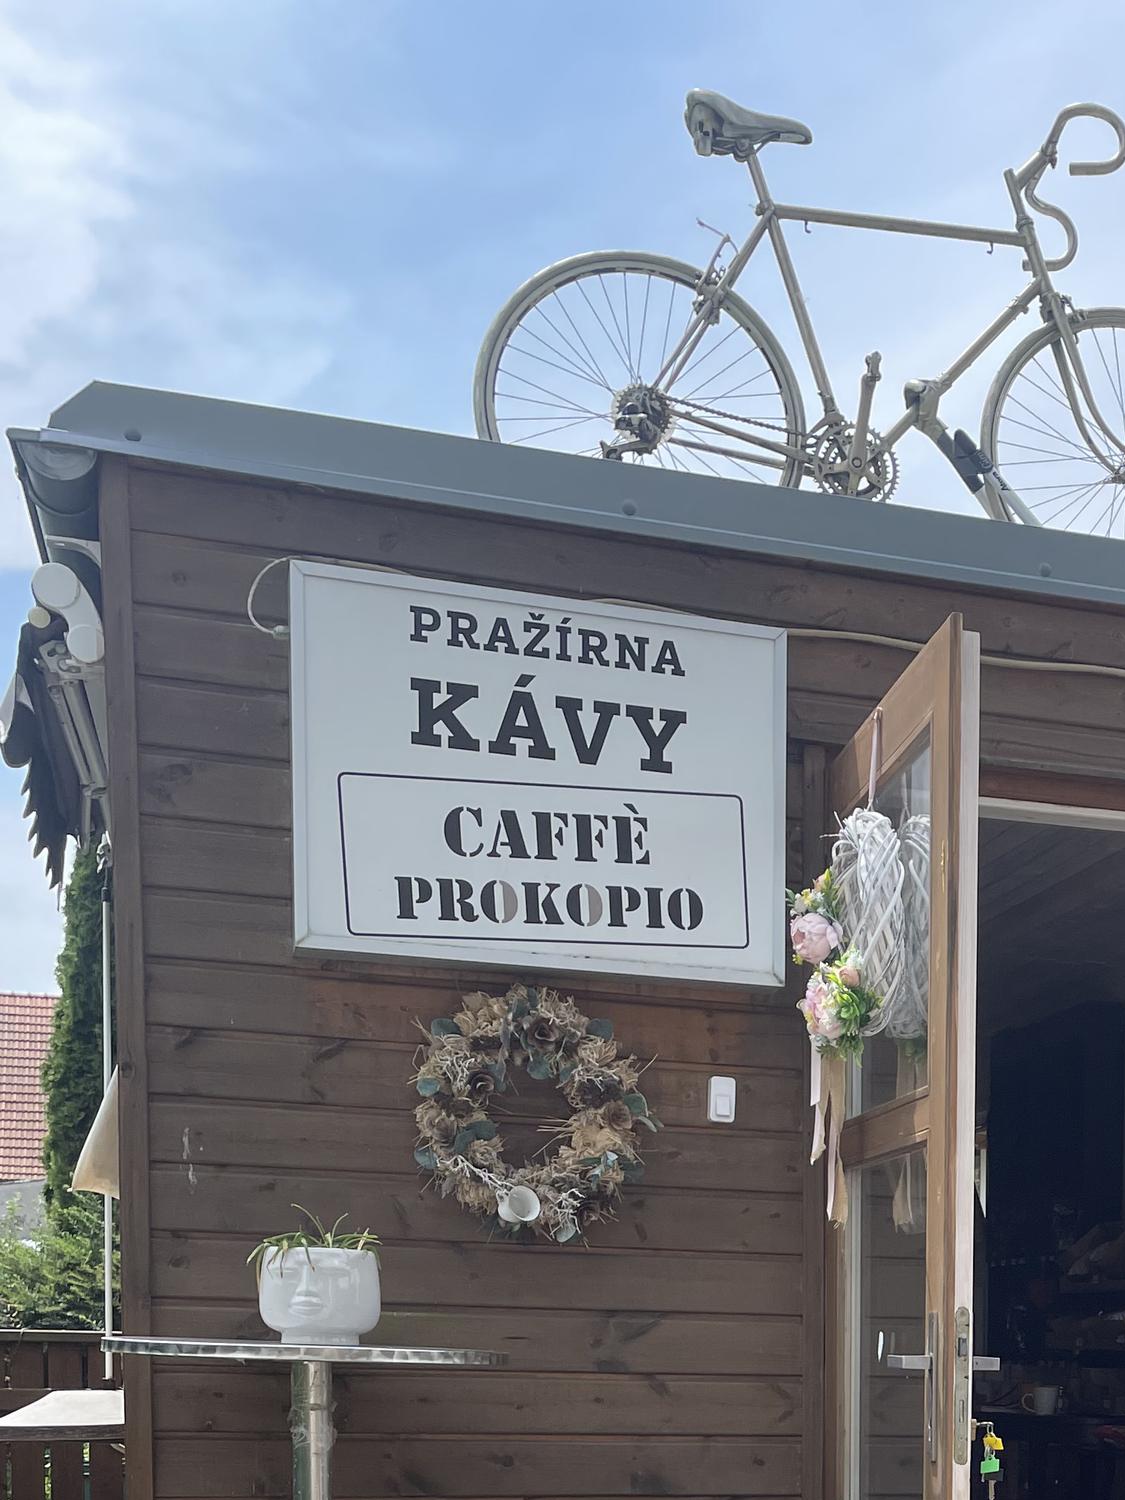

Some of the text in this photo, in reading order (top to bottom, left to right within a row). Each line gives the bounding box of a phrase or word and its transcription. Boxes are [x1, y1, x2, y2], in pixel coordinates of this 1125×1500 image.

[410, 605, 686, 678] PRAŽÍRNA
[410, 674, 688, 775] KÁVY
[444, 803, 651, 866] CAFFÈ
[394, 876, 704, 931] PROKOPIO
